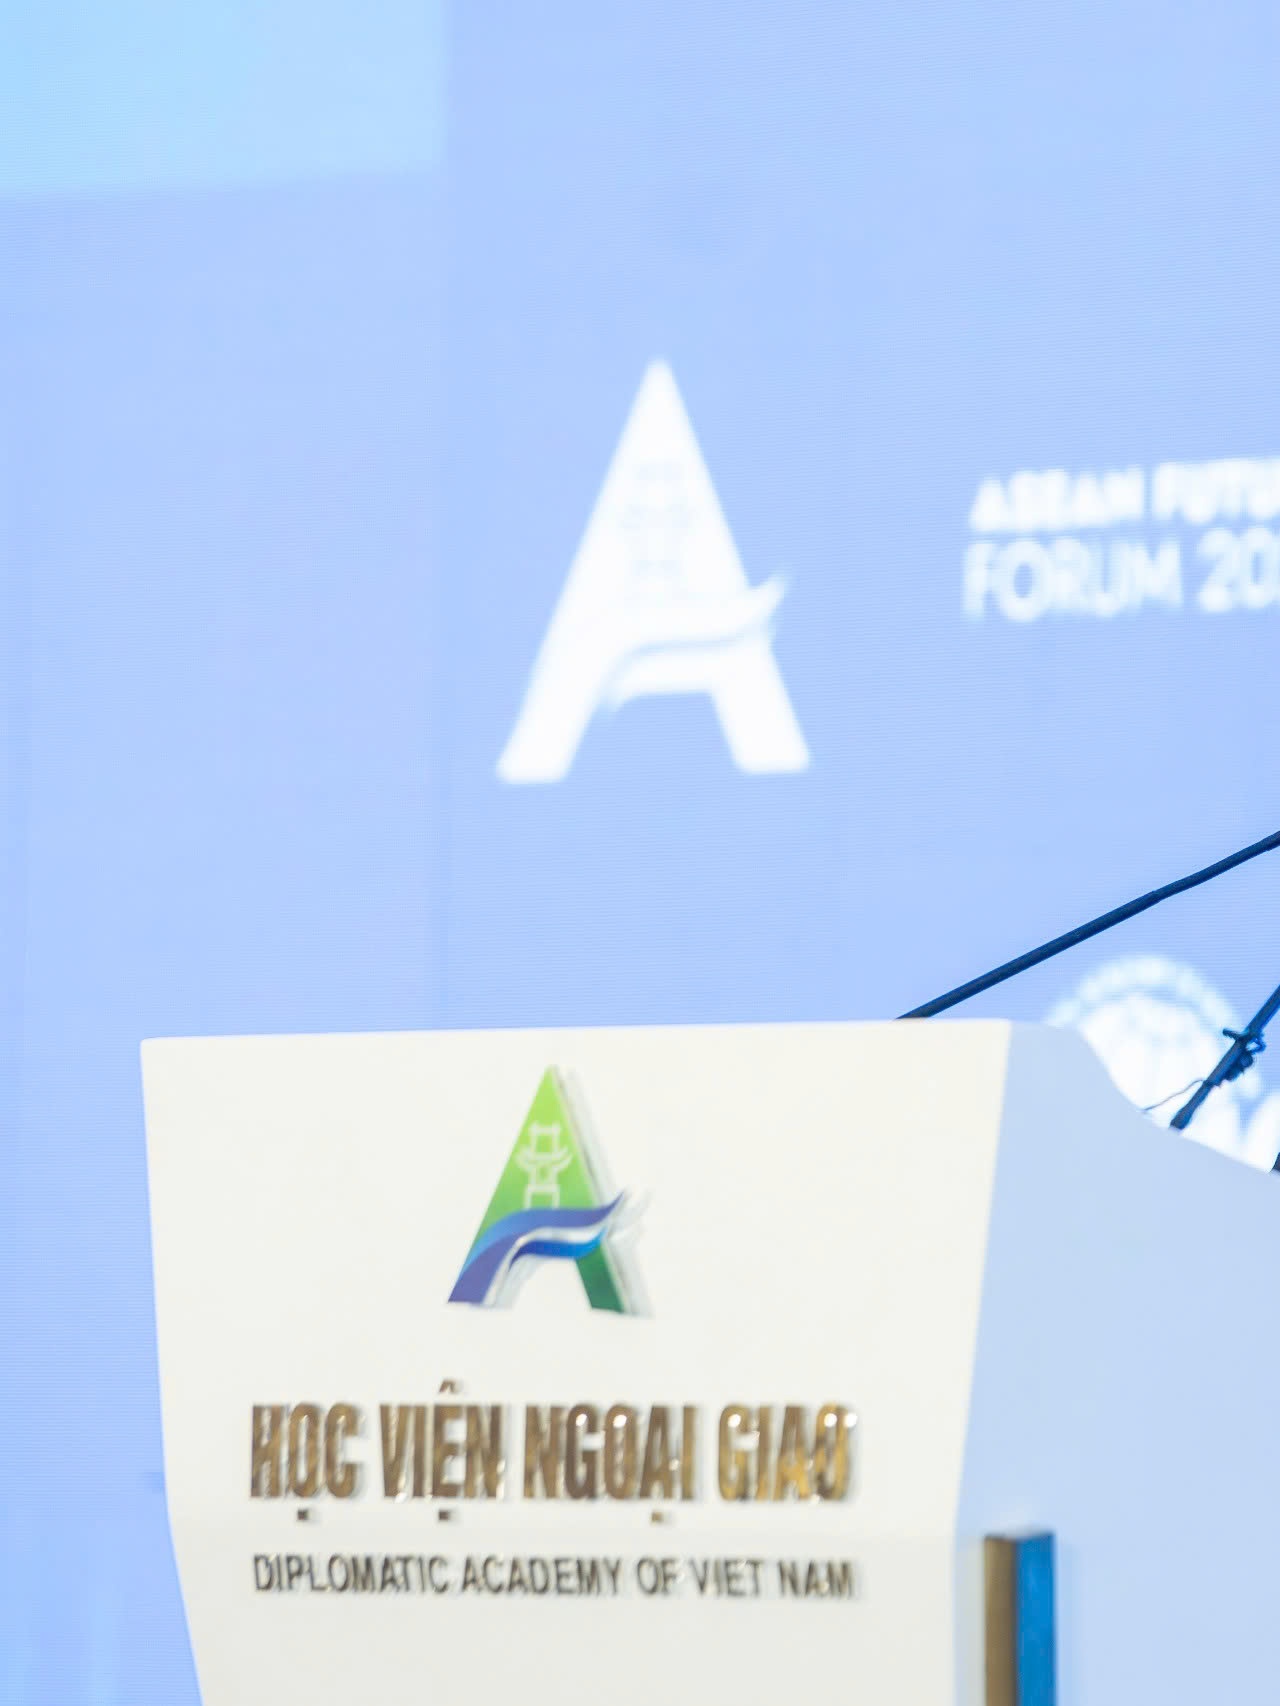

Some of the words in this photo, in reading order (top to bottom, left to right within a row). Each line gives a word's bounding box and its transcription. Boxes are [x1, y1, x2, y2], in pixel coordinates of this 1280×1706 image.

[963, 538, 1184, 622] FORUM
[250, 1402, 362, 1522] HỌC
[379, 1378, 505, 1522] VIỆN
[524, 1402, 697, 1523] NGOẠI
[718, 1402, 855, 1501] GIAO
[253, 1553, 451, 1594] DIPLOMATIC
[462, 1554, 621, 1596] ACADEMY
[637, 1557, 682, 1596] OF
[690, 1558, 764, 1597] VIET
[777, 1558, 855, 1598] NAM
